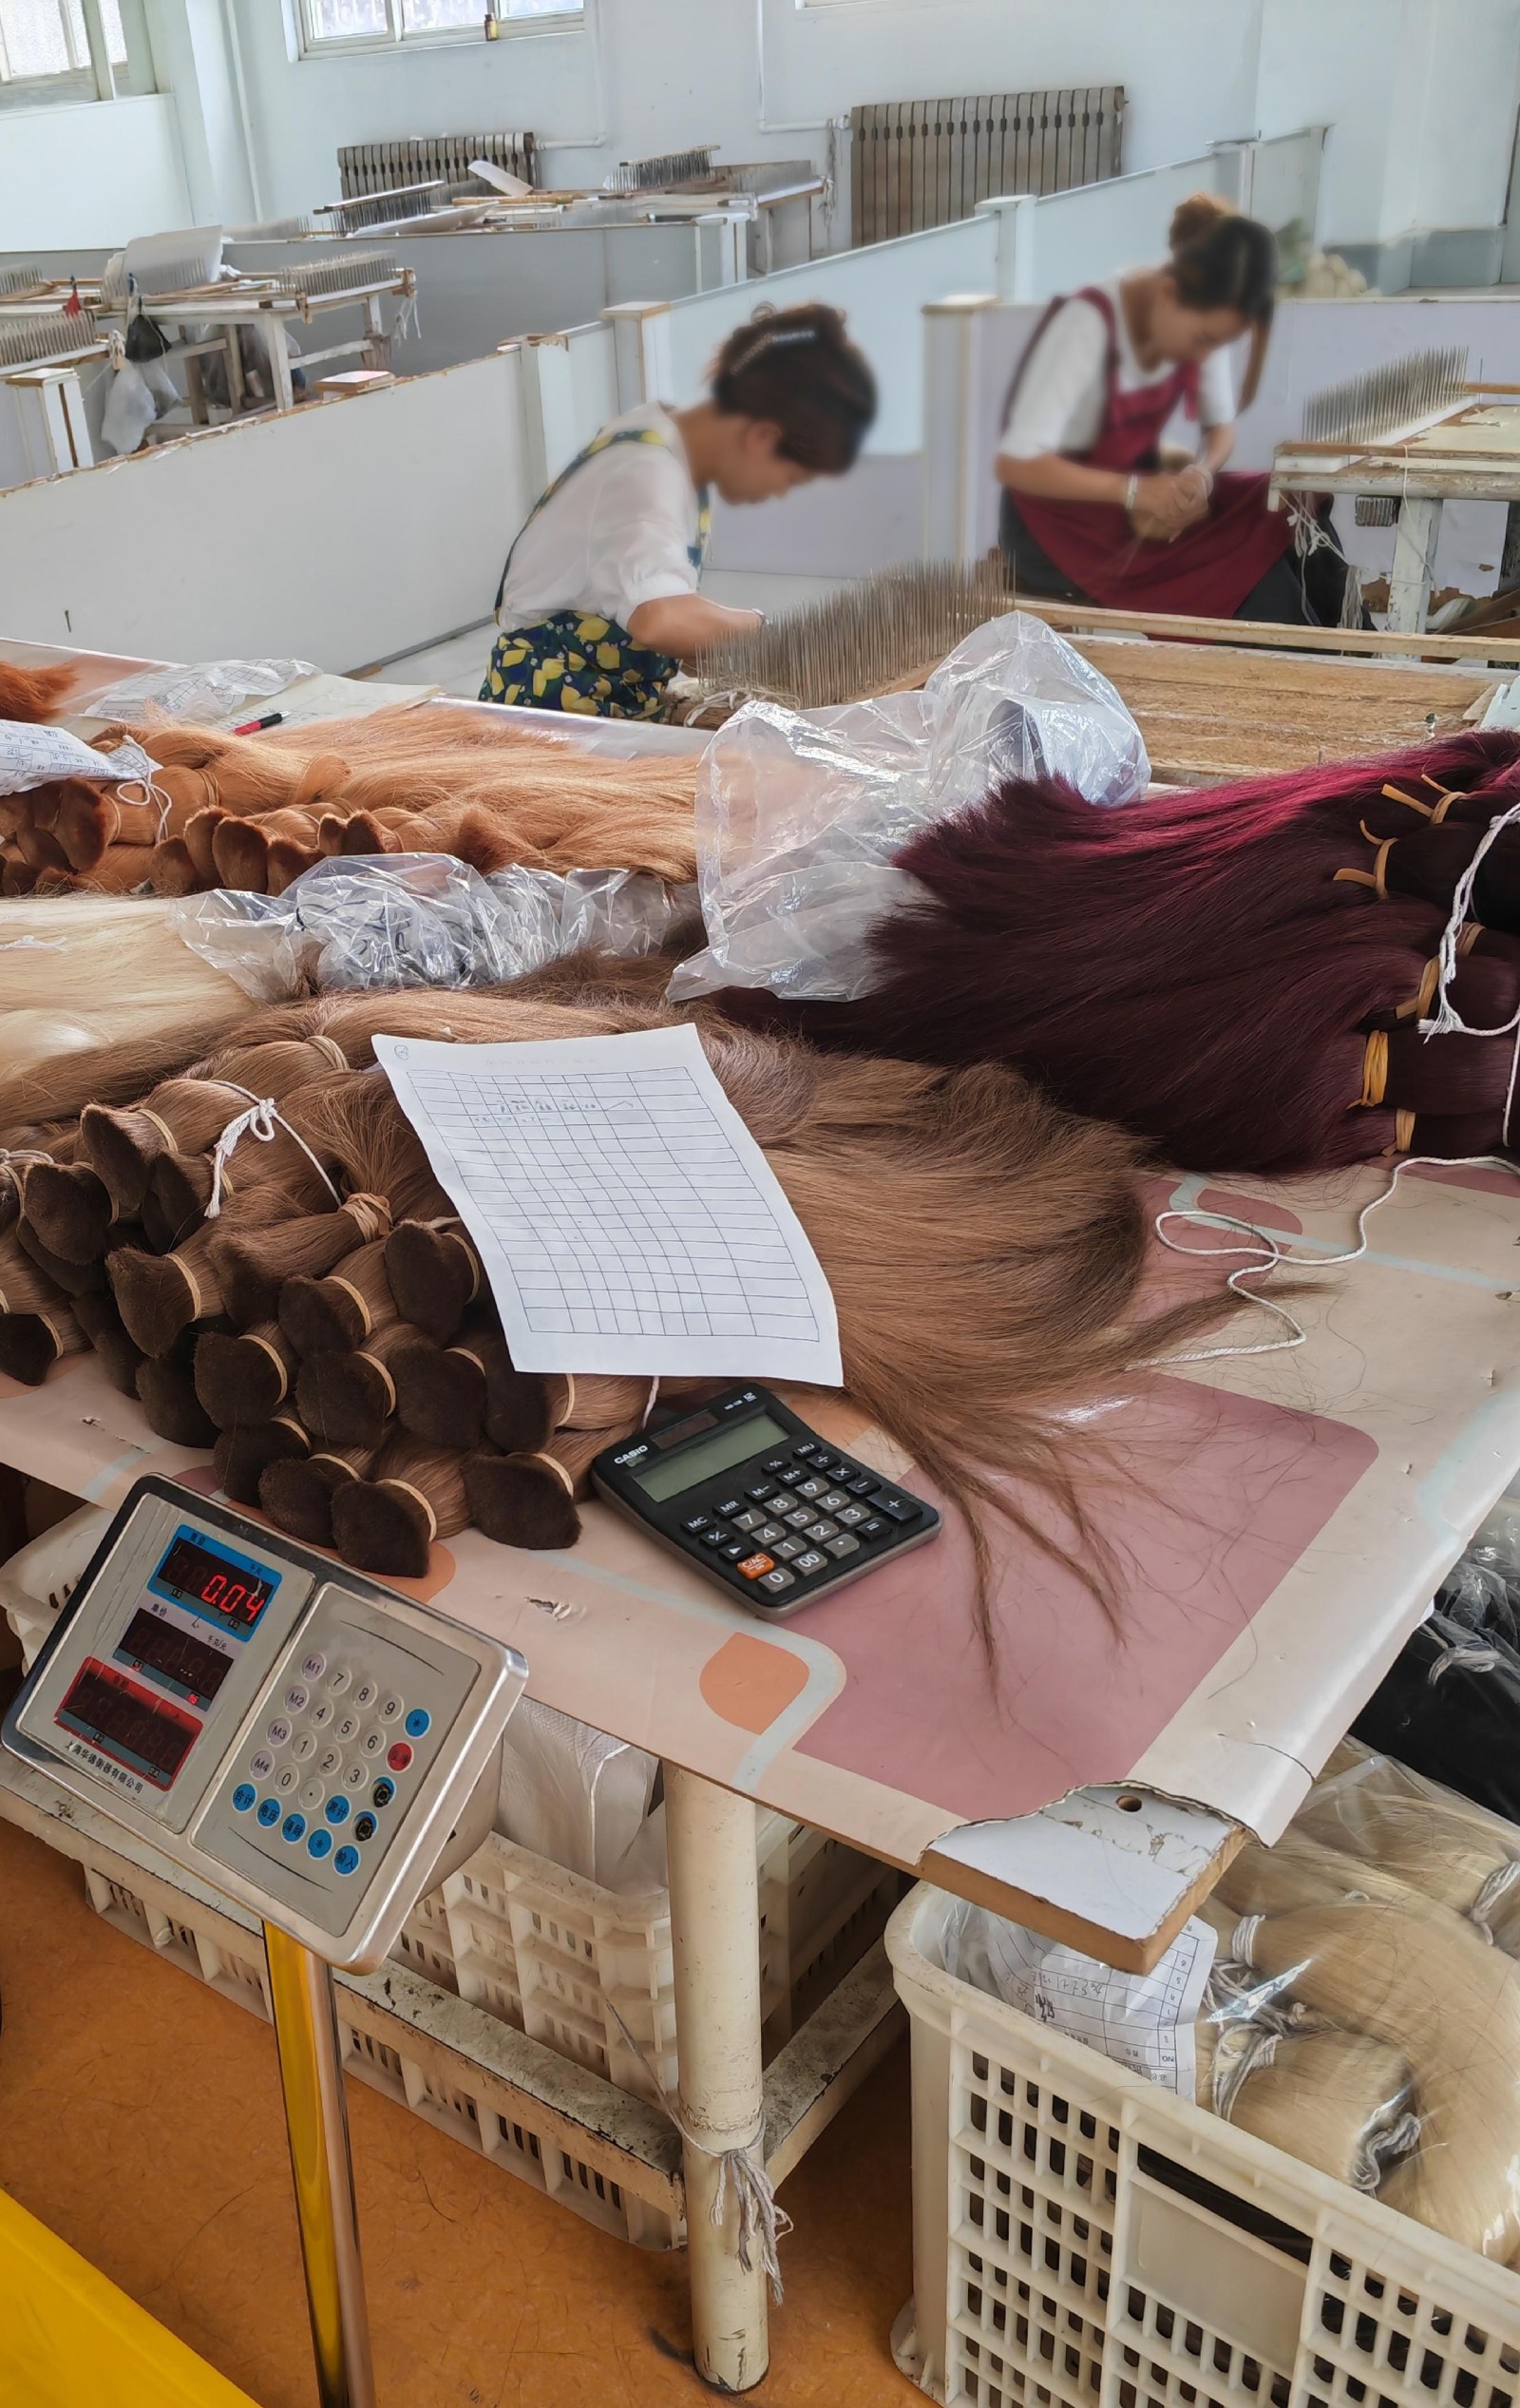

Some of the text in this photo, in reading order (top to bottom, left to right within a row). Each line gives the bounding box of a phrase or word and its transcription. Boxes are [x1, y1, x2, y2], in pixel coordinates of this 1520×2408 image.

[614, 1444, 648, 1464] CASIO
[798, 1443, 815, 1454] MU
[783, 1469, 801, 1481] M+
[804, 1481, 817, 1493] 9
[720, 1500, 739, 1513] MR
[772, 1499, 788, 1509] 8
[826, 1496, 841, 1506] 6
[740, 1514, 754, 1525] 7
[792, 1511, 808, 1522] 5
[845, 1508, 861, 1519] 3
[688, 1516, 708, 1529] MC
[763, 1528, 777, 1538] 4
[812, 1525, 830, 1537] 2
[782, 1542, 797, 1552] 1
[798, 1554, 820, 1568] 00
[769, 1573, 784, 1583] 0
[200, 1575, 265, 1622] 0.04
[151, 1603, 167, 1617] 单价
[305, 1659, 321, 1674] M1
[332, 1672, 344, 1687] 7
[289, 1692, 305, 1708] M2
[358, 1687, 369, 1701] 8
[315, 1707, 326, 1721] 4
[384, 1701, 395, 1715] 9
[271, 1725, 287, 1740] M3
[340, 1720, 352, 1734] 5
[300, 1740, 309, 1753] 1
[367, 1735, 378, 1749] 6
[254, 1758, 270, 1772] M4
[322, 1753, 334, 1768] 2
[281, 1772, 292, 1787] 0
[349, 1768, 360, 1783] 3
[234, 1789, 254, 1806] 合计
[259, 1805, 279, 1823] 电压
